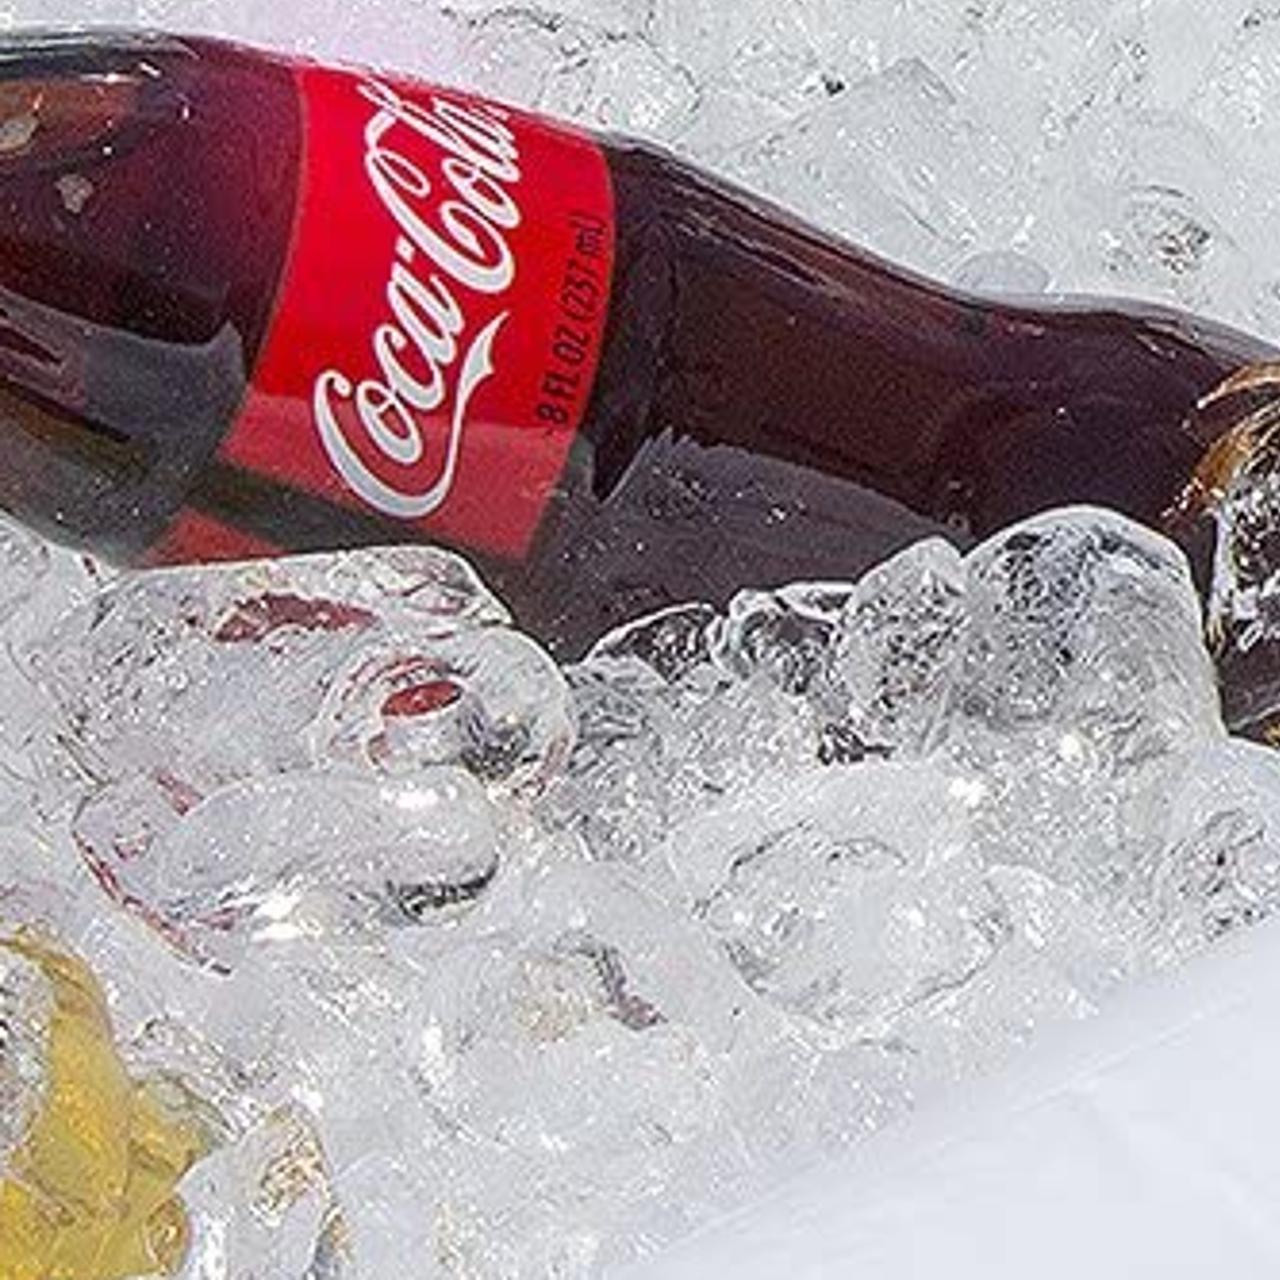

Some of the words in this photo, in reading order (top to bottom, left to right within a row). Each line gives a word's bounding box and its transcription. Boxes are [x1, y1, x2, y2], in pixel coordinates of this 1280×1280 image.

[313, 74, 522, 519] Coca-Cola
[552, 324, 591, 366] OZ
[543, 372, 580, 400] FL
[536, 403, 569, 425] 8
